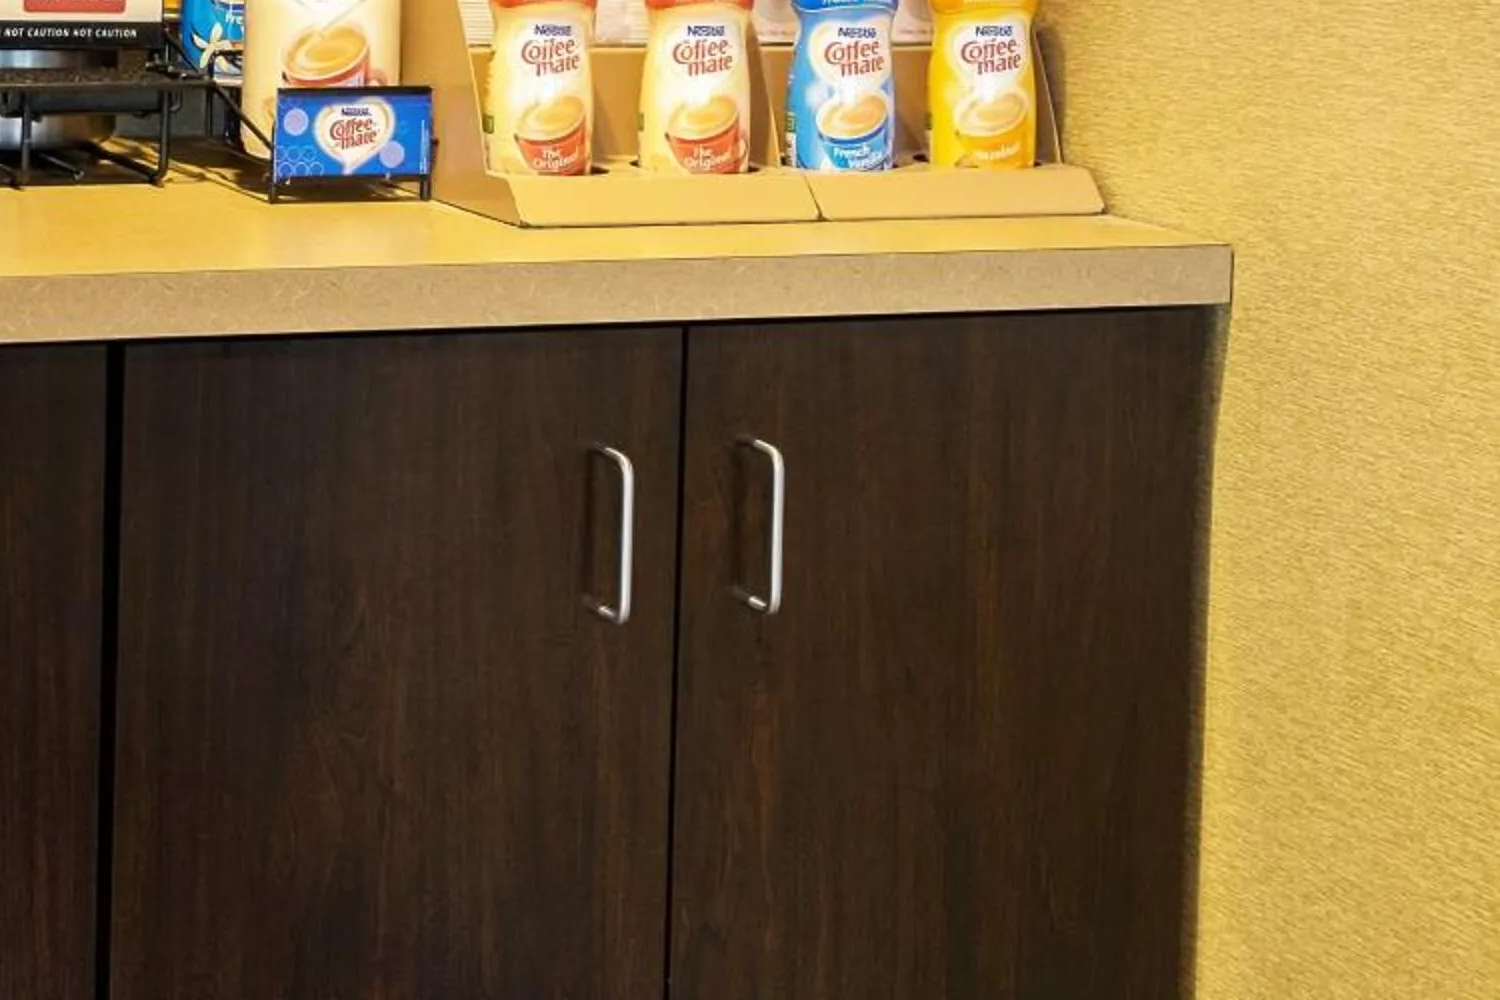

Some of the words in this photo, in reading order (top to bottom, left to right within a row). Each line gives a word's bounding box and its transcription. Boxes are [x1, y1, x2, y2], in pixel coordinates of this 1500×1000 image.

[27, 27, 69, 38] CAUTION
[95, 28, 137, 39] CAUTION
[535, 55, 580, 77] mate
[688, 55, 733, 77] mate
[840, 56, 885, 77] mate
[977, 54, 1022, 75] mate
[339, 130, 378, 149] mate
